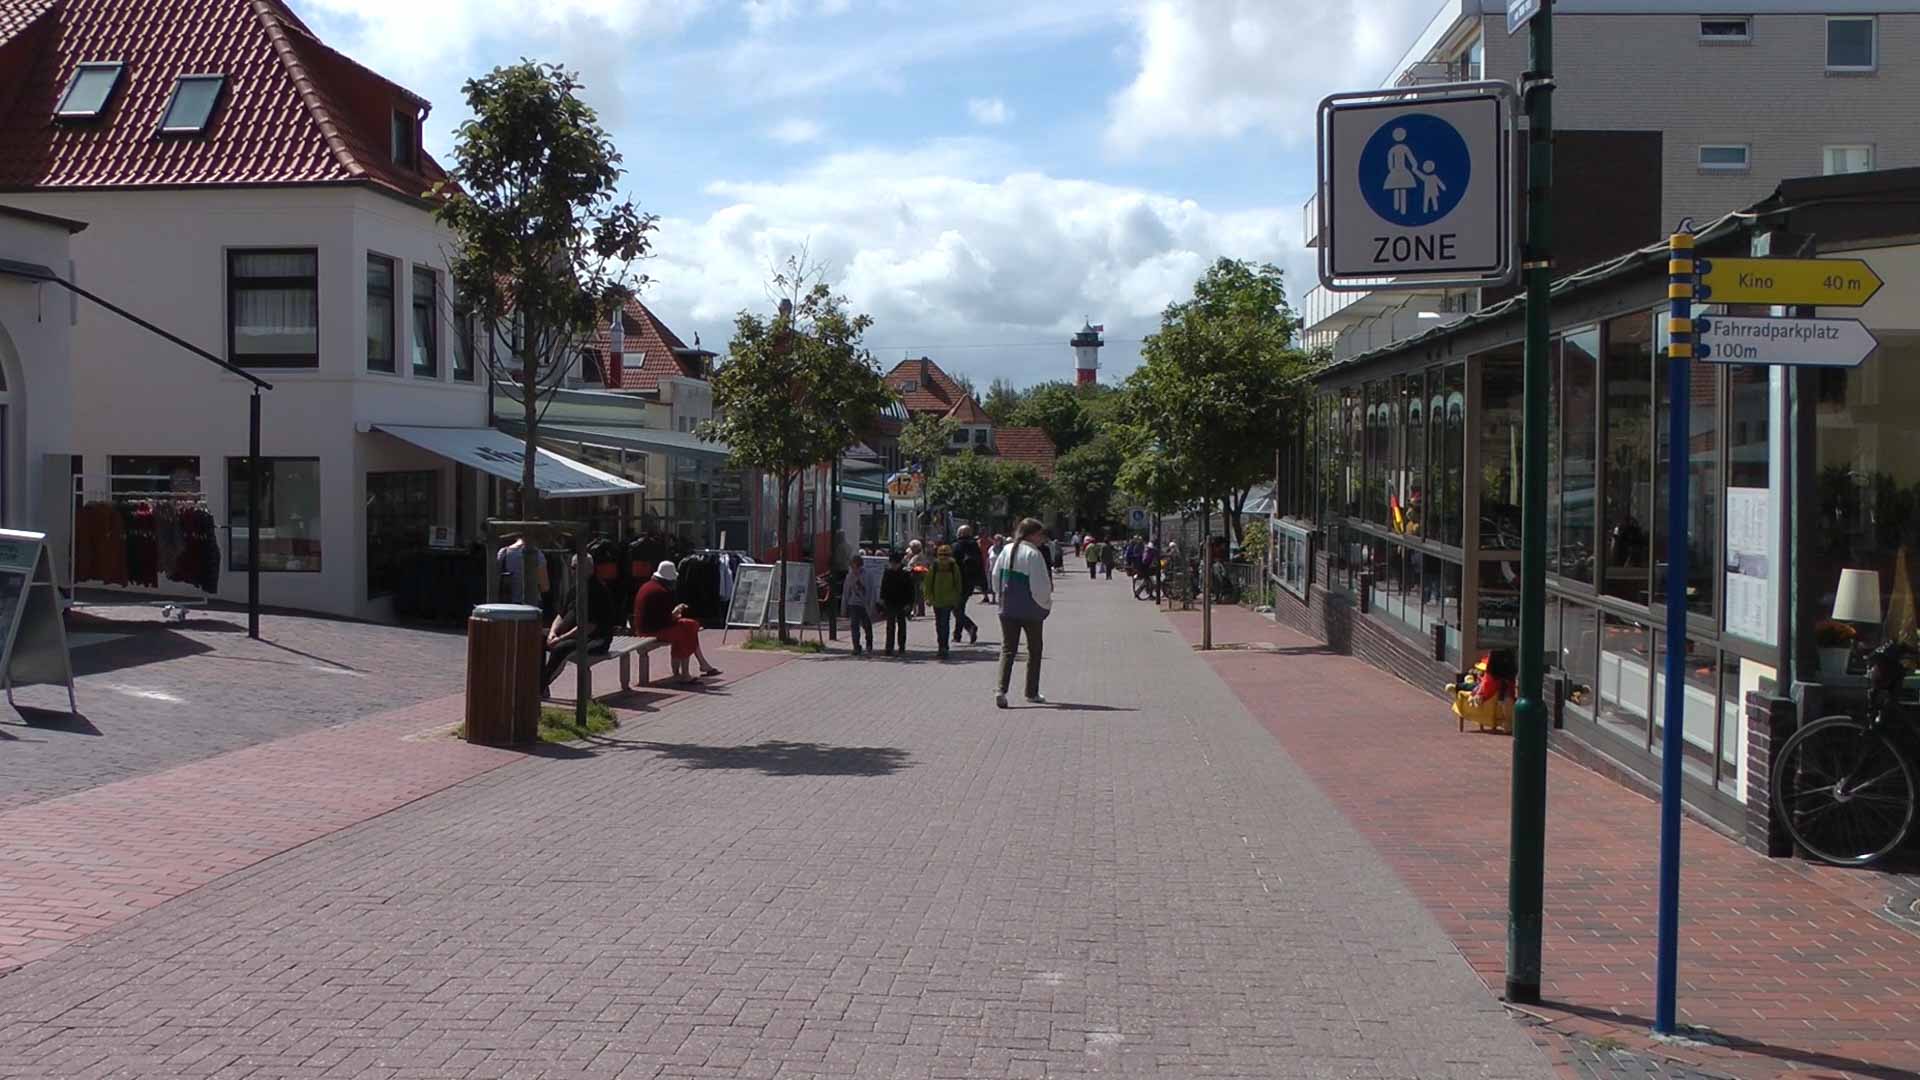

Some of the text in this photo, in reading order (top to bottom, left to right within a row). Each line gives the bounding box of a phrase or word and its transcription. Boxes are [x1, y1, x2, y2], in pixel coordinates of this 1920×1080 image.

[1373, 233, 1456, 263] ZONE
[1738, 274, 1861, 290] Kino 40 m
[1714, 320, 1839, 341] Fahrradparkplatz
[1714, 343, 1757, 359] 100m
